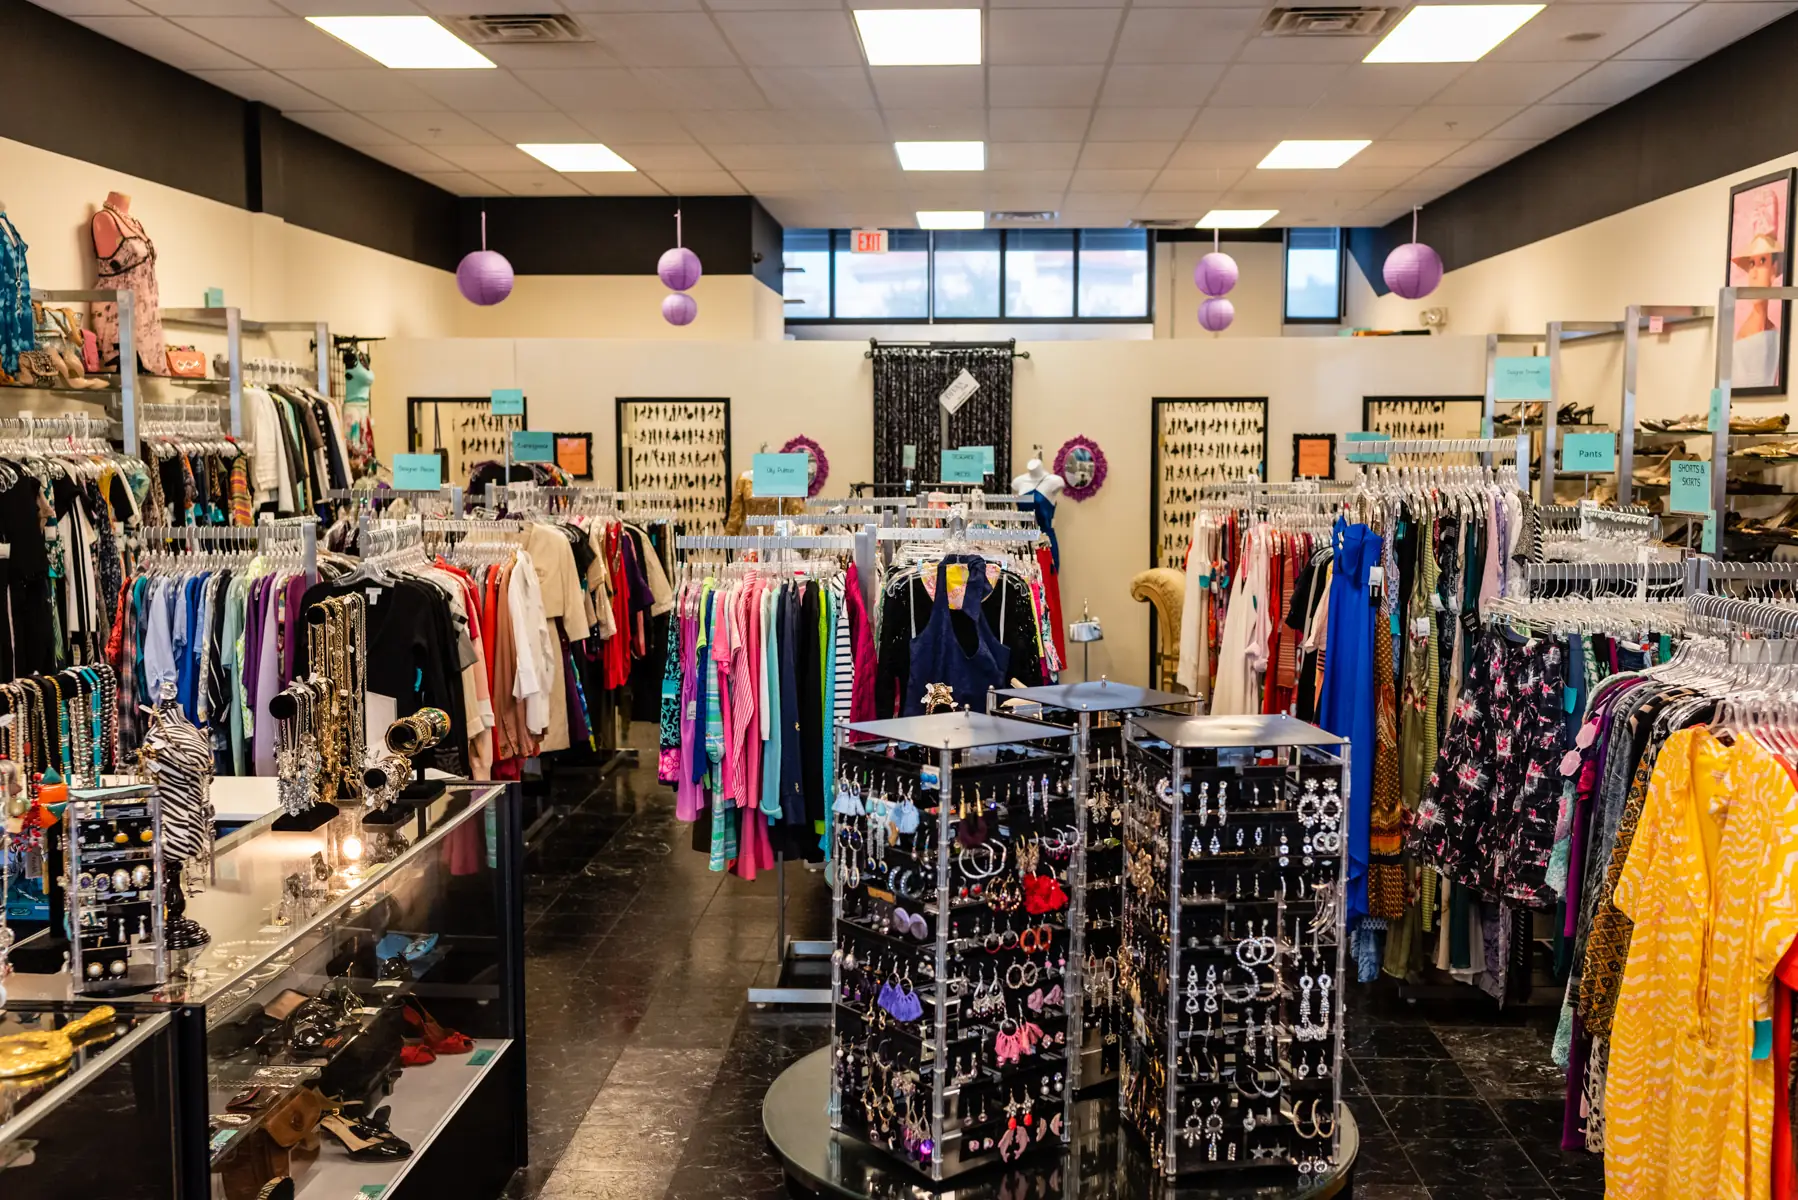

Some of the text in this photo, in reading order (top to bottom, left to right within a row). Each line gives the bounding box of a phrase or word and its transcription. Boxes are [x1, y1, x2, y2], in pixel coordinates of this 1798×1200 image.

[857, 232, 881, 252] EXIT
[1579, 449, 1602, 458] Pants
[1678, 463, 1705, 474] SHORTS &
[1682, 477, 1701, 487] SKIRTS
